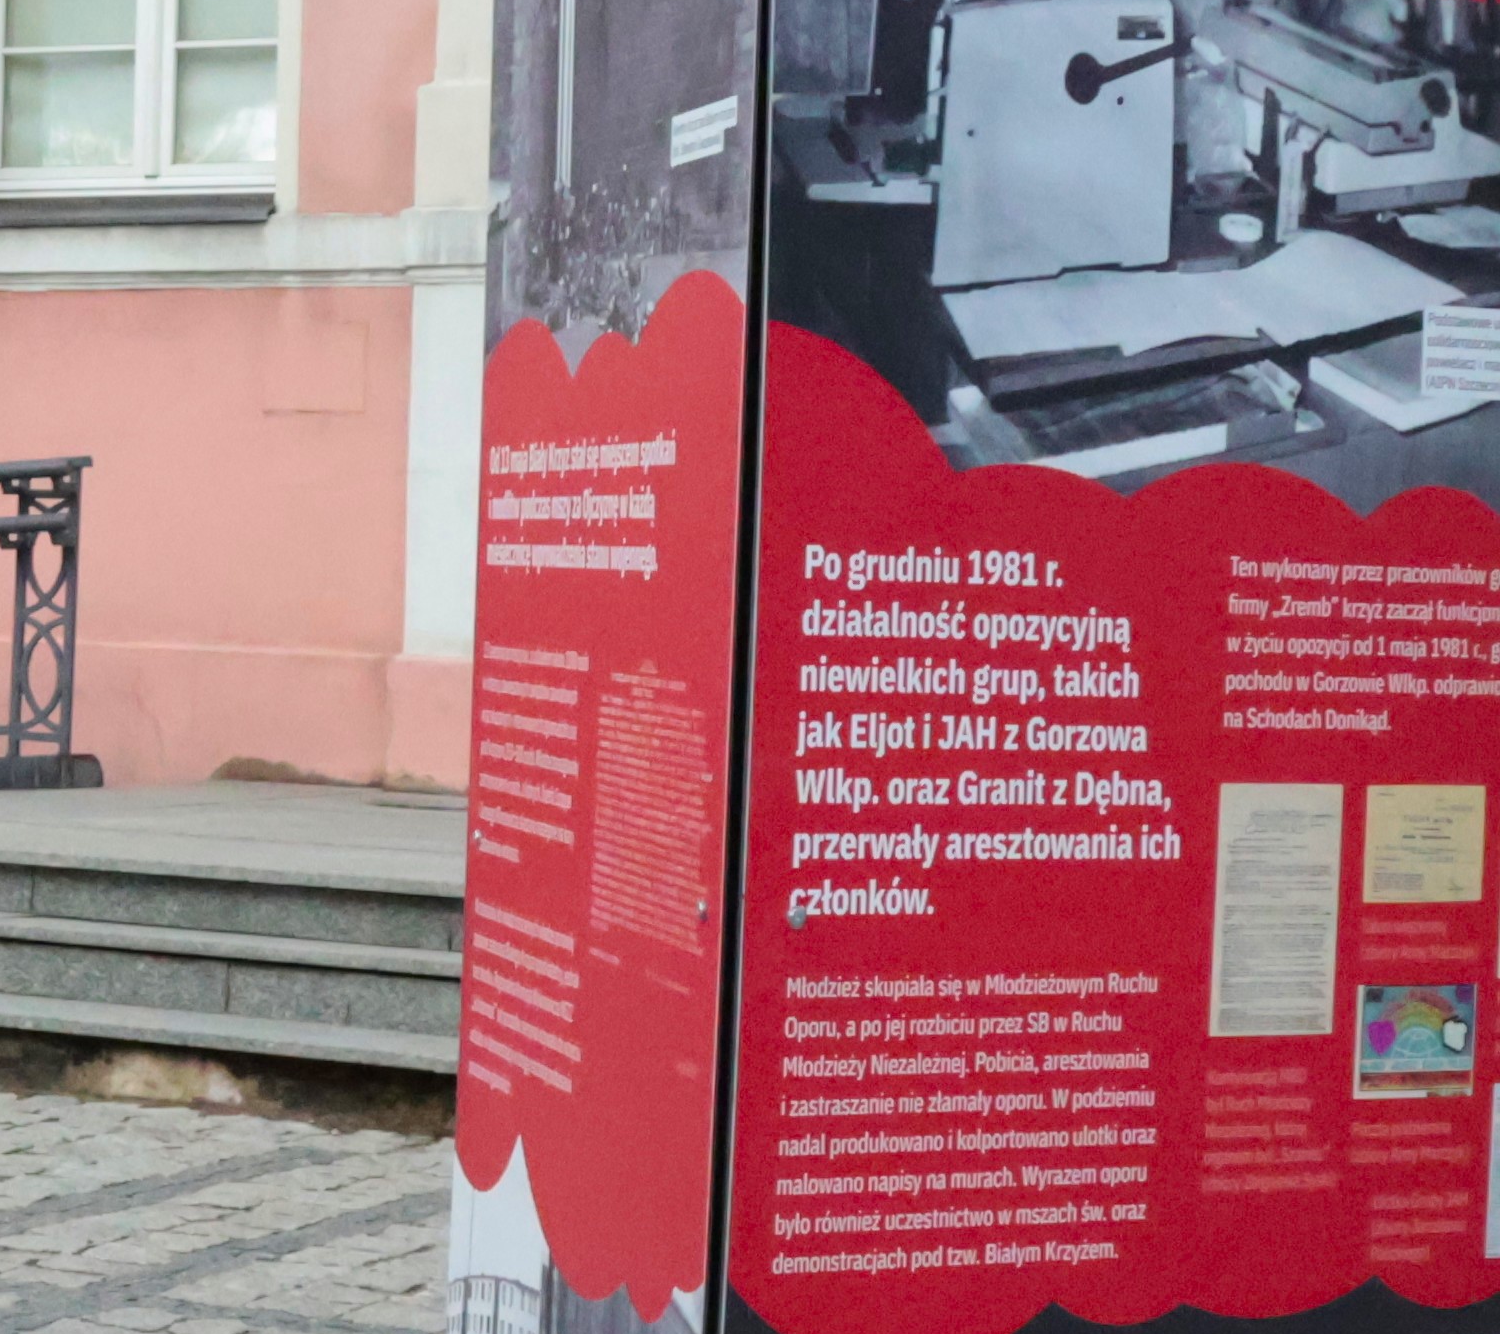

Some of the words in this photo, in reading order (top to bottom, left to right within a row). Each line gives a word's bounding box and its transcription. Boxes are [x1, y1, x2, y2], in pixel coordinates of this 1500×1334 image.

[805, 545, 842, 580] Po
[847, 546, 959, 590] grudniu
[968, 550, 1038, 586] 1981
[1046, 561, 1063, 587] r.
[802, 599, 966, 639] działalność
[973, 607, 1130, 652] opozycyjną
[800, 655, 965, 694] niewielkich
[972, 664, 1045, 704] grup,
[1053, 662, 1139, 698] takich
[796, 711, 842, 756] jak
[850, 712, 915, 757] Eljot
[923, 713, 931, 749] i
[938, 715, 996, 749] JAH
[1003, 724, 1019, 750] z
[1027, 716, 1147, 752] Gorzowa
[796, 768, 879, 813] Wlkp.
[887, 778, 950, 805] oraz
[958, 769, 1046, 805] Granit
[1052, 779, 1067, 805] z
[1075, 771, 1171, 815] Dębna,
[793, 824, 940, 868] przerwały
[945, 824, 1133, 860] aresztowania
[1140, 824, 1180, 860] ich
[789, 876, 935, 916] członków.
